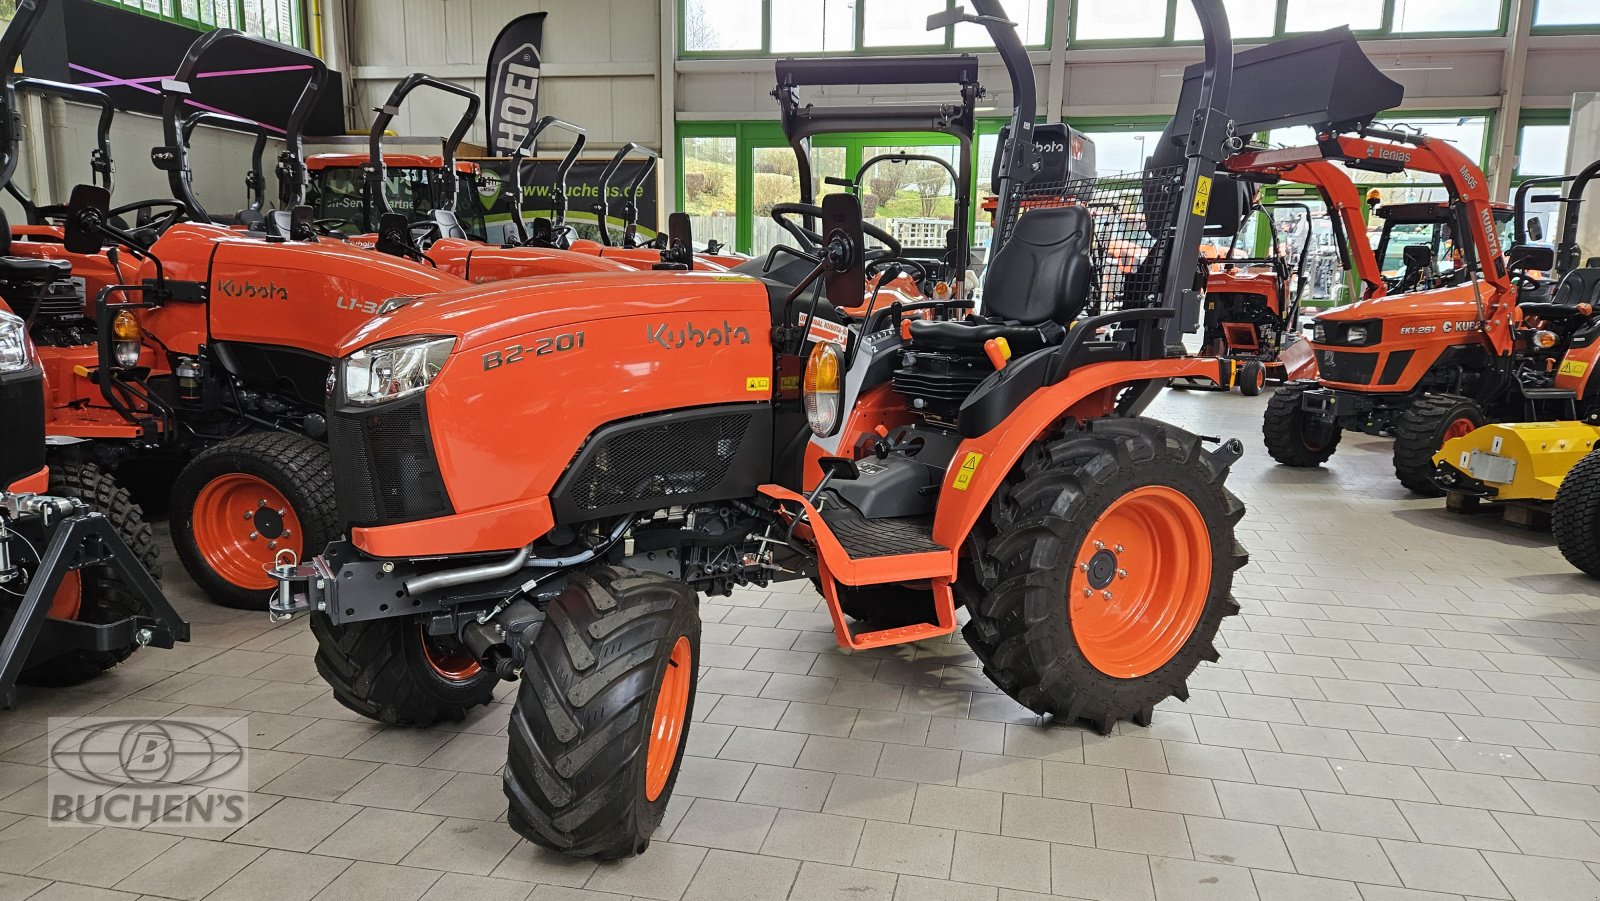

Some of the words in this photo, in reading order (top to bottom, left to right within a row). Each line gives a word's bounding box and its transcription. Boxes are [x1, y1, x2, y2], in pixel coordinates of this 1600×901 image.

[496, 62, 540, 157] HOEI
[1034, 140, 1064, 153] bota
[1379, 146, 1411, 163] tenias
[1459, 164, 1478, 190] Me05
[520, 182, 644, 198] ww.uches.e
[1480, 207, 1497, 257] KUBOTA
[217, 279, 289, 300] Kubota
[646, 320, 751, 350] Kubota
[1400, 325, 1437, 335] EK1-261
[482, 331, 585, 371] B2-201
